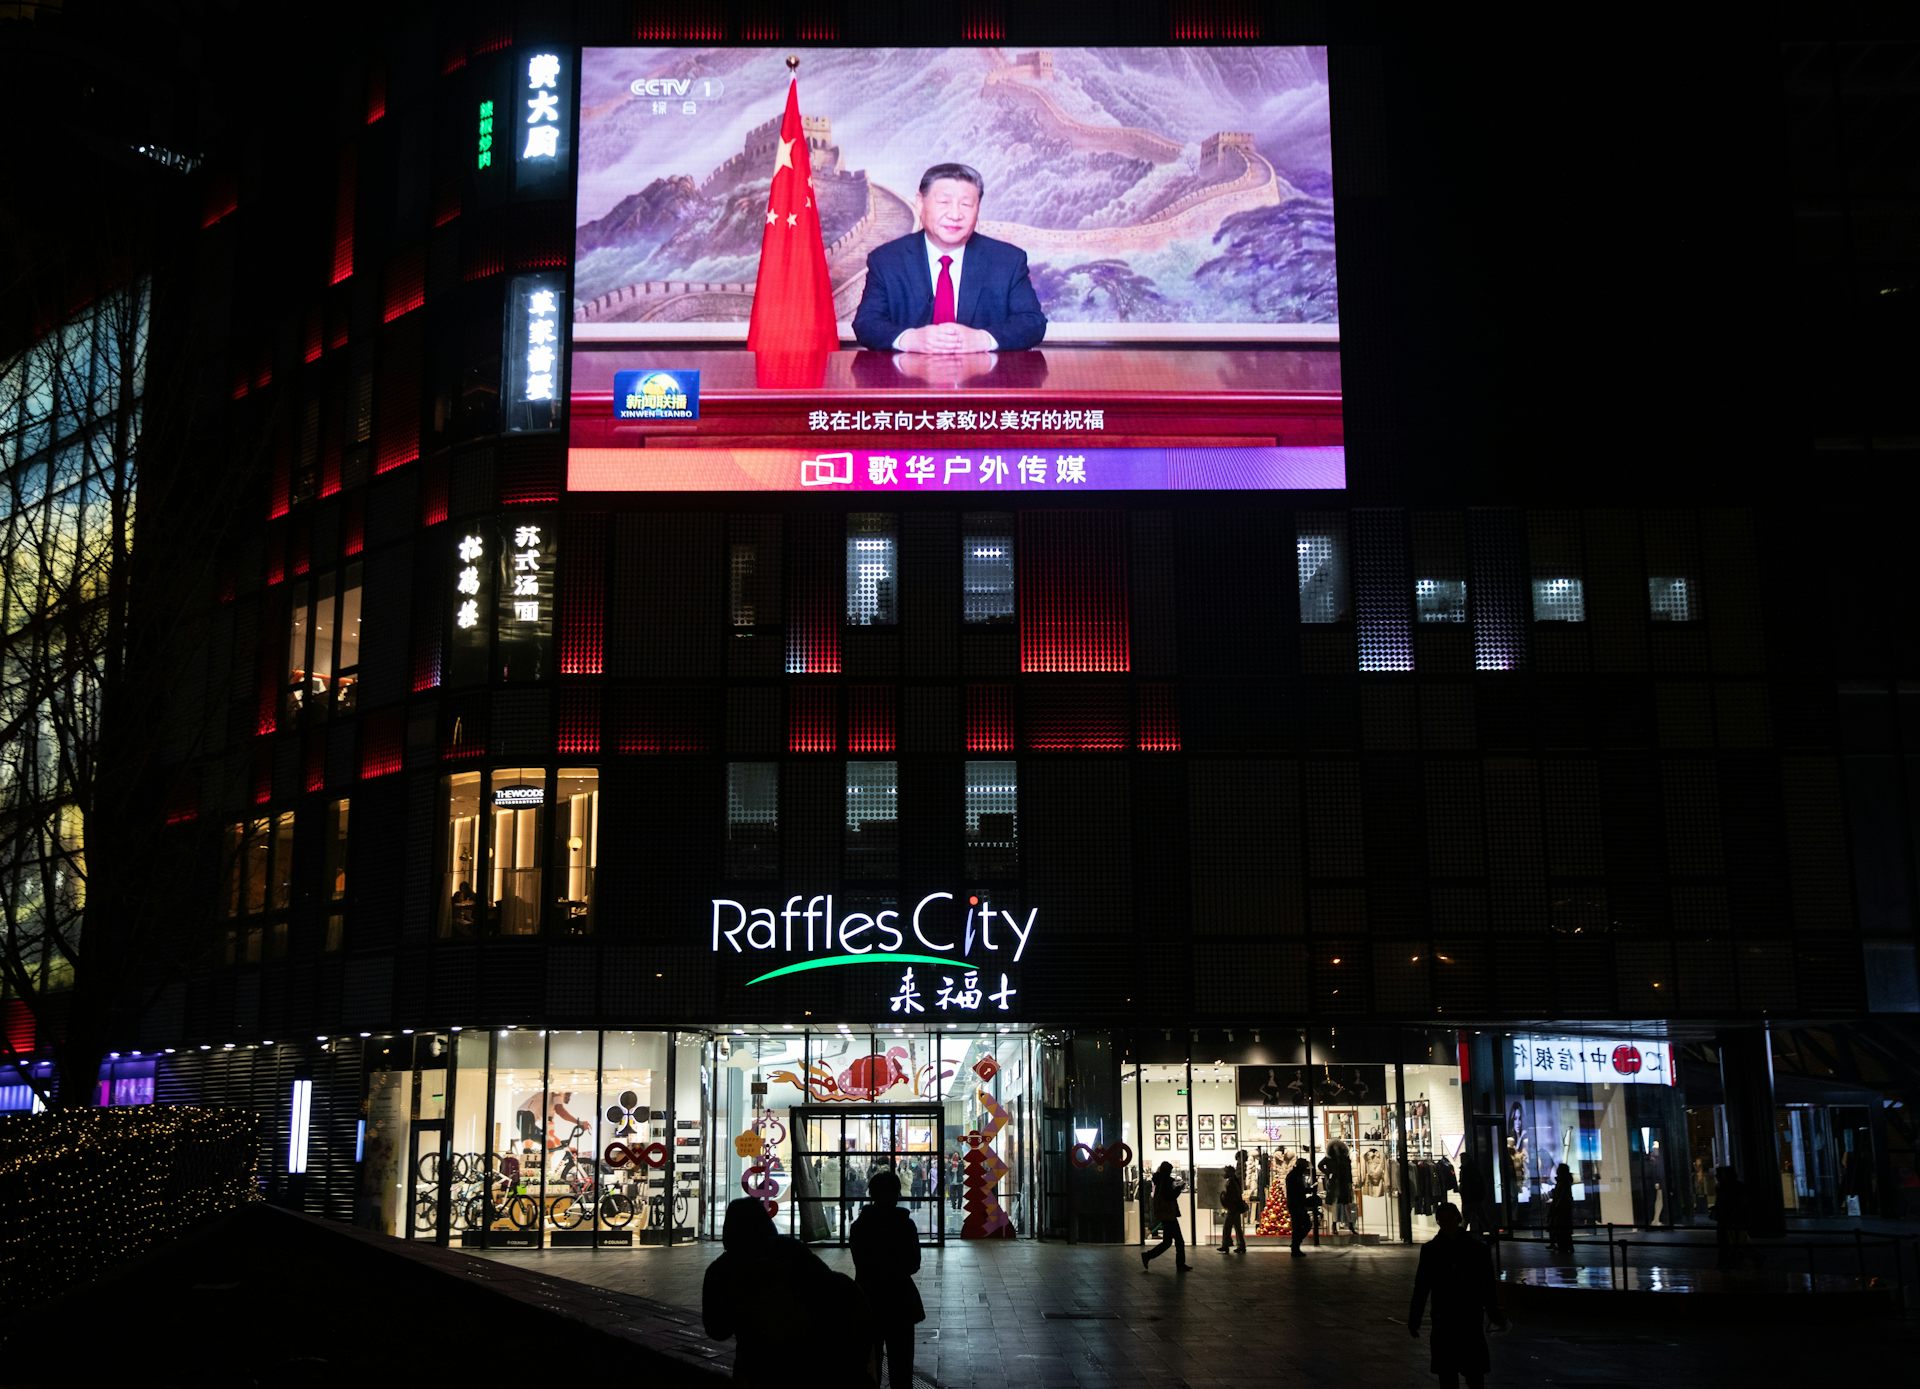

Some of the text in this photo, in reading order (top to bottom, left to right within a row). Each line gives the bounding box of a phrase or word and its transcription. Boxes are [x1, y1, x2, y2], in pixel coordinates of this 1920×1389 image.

[630, 78, 712, 97] CCTV 1
[651, 100, 697, 116] 综合
[626, 393, 688, 410] 新闻联播
[620, 410, 693, 418] XINWEN LIANBO
[808, 409, 1105, 431] 我在北京向大家致以美好的祝福
[867, 455, 1087, 486] 歌华户外传媒
[513, 525, 542, 622] 苏式汤面
[711, 891, 1039, 963] Raffles City
[889, 966, 1017, 1014] 来福士
